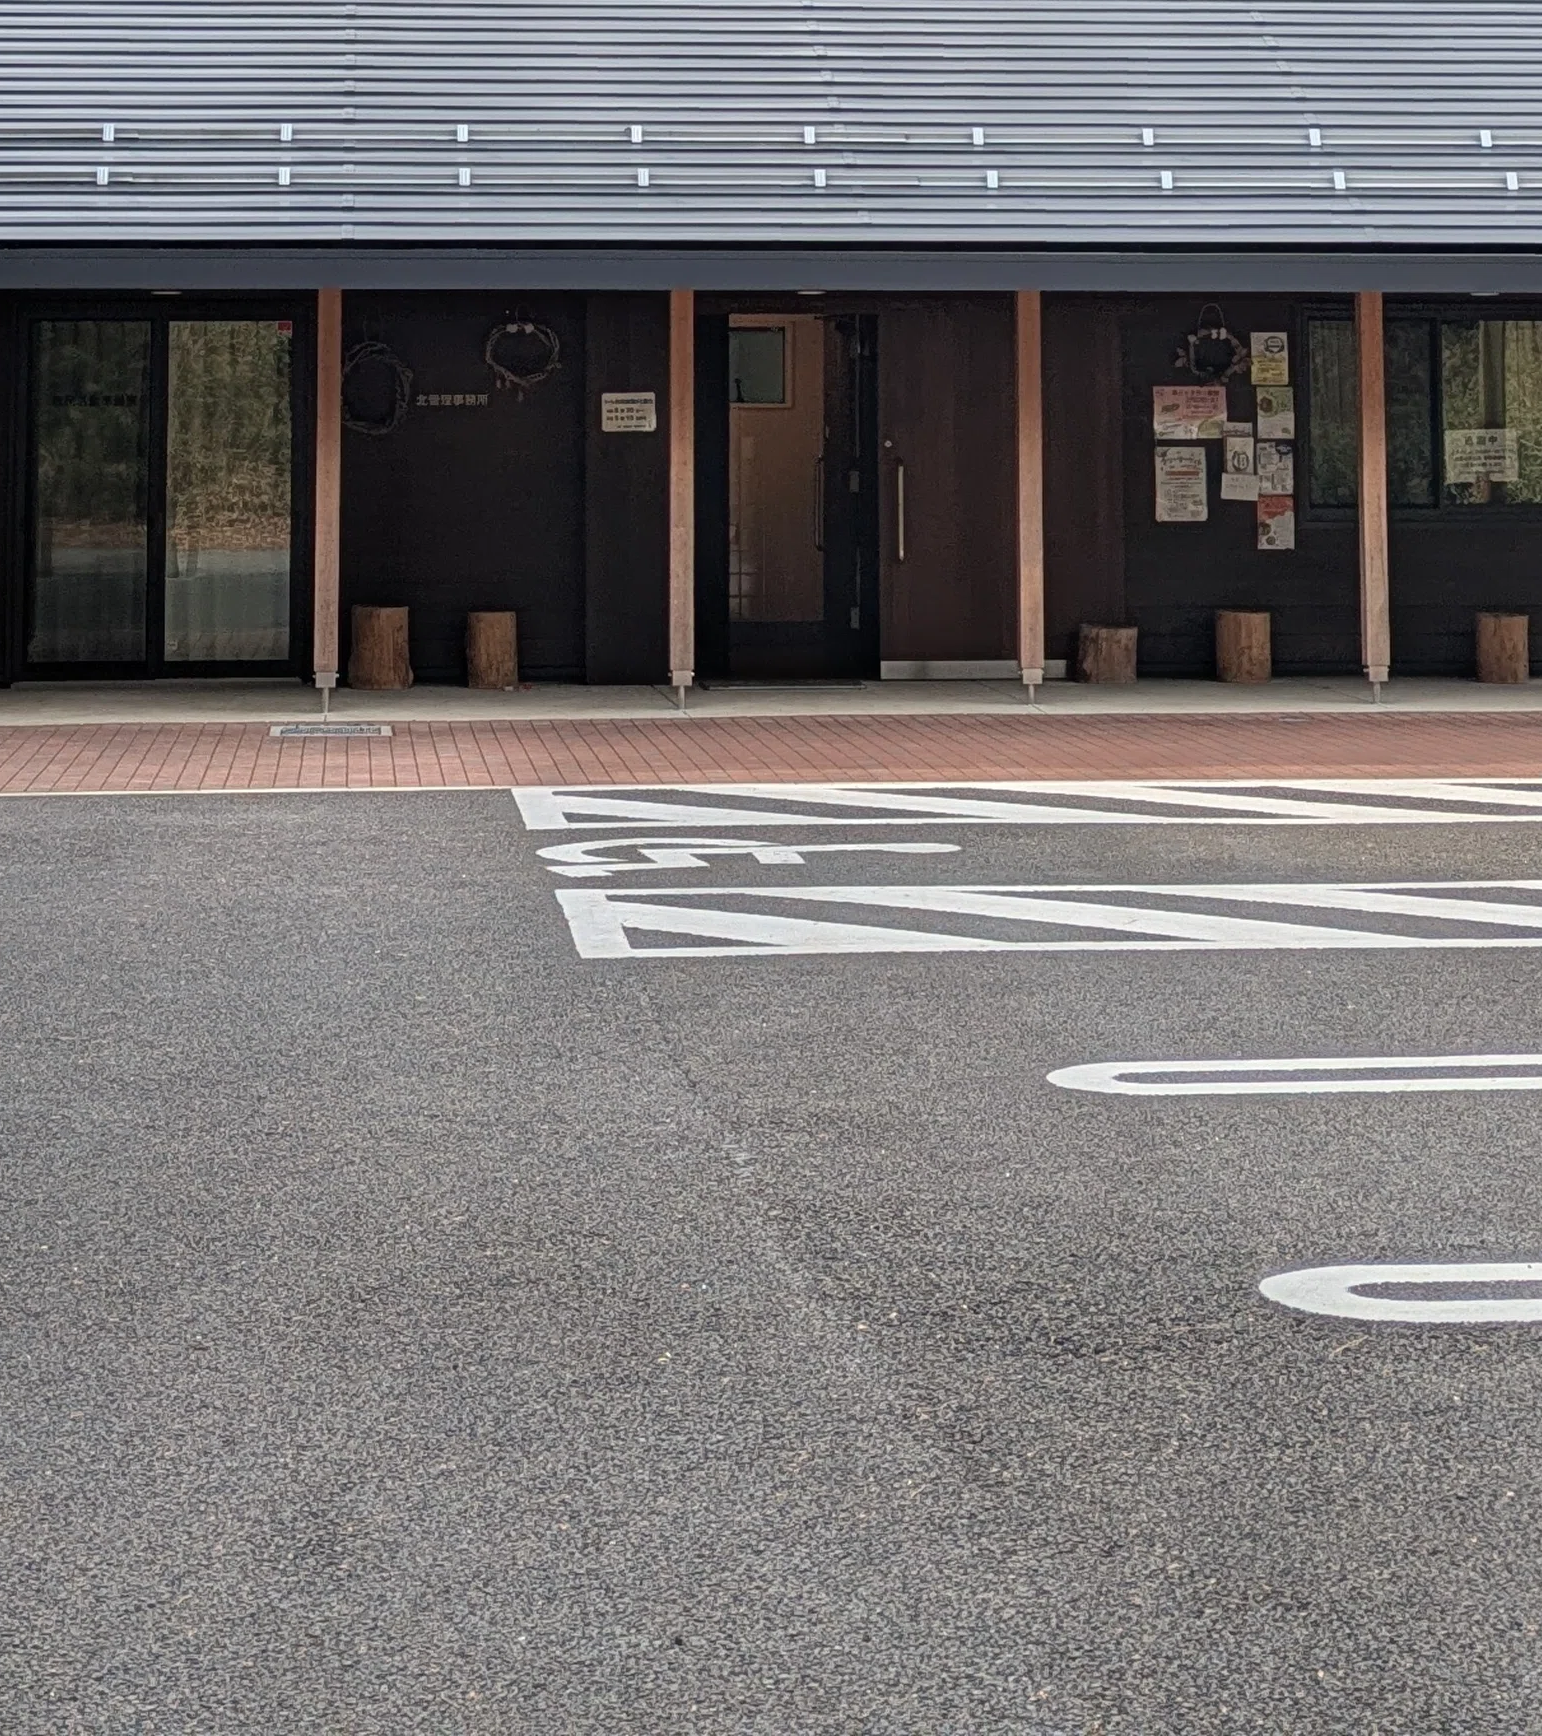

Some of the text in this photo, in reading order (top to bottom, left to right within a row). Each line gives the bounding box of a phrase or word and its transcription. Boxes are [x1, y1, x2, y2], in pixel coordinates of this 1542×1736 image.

[416, 393, 489, 407] 北管理事務所
